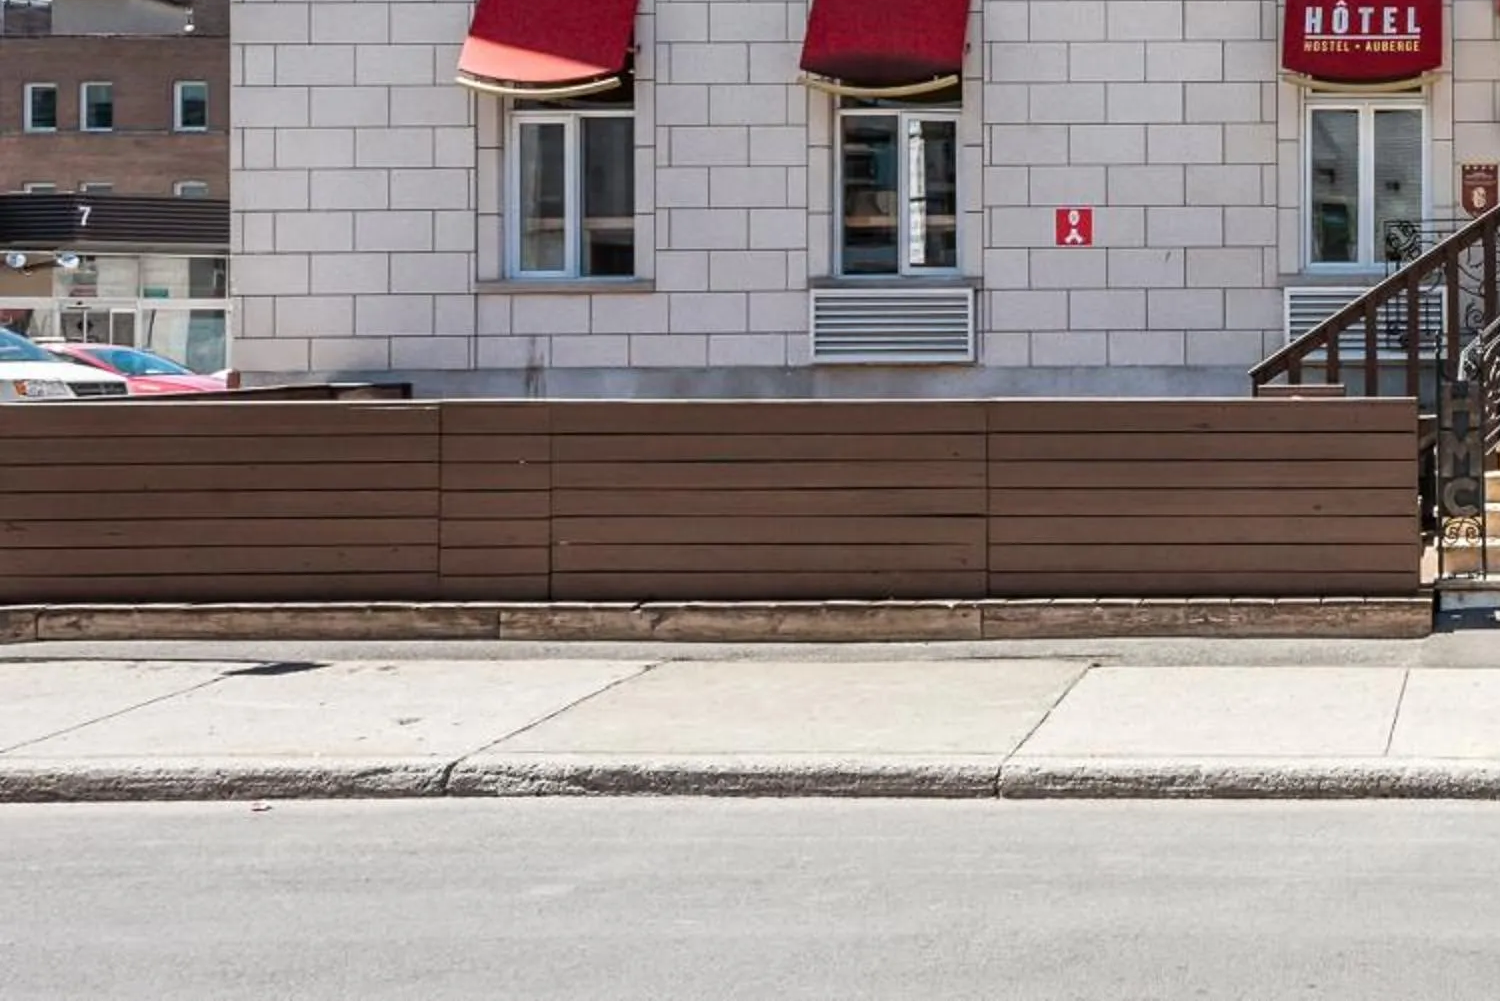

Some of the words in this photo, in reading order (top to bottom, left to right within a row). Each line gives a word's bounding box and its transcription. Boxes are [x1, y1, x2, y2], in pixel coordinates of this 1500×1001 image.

[1304, 0, 1421, 34] HÔTEL
[1304, 40, 1350, 52] HOSTEL
[1365, 40, 1421, 52] AUBERGE
[78, 206, 92, 226] 7
